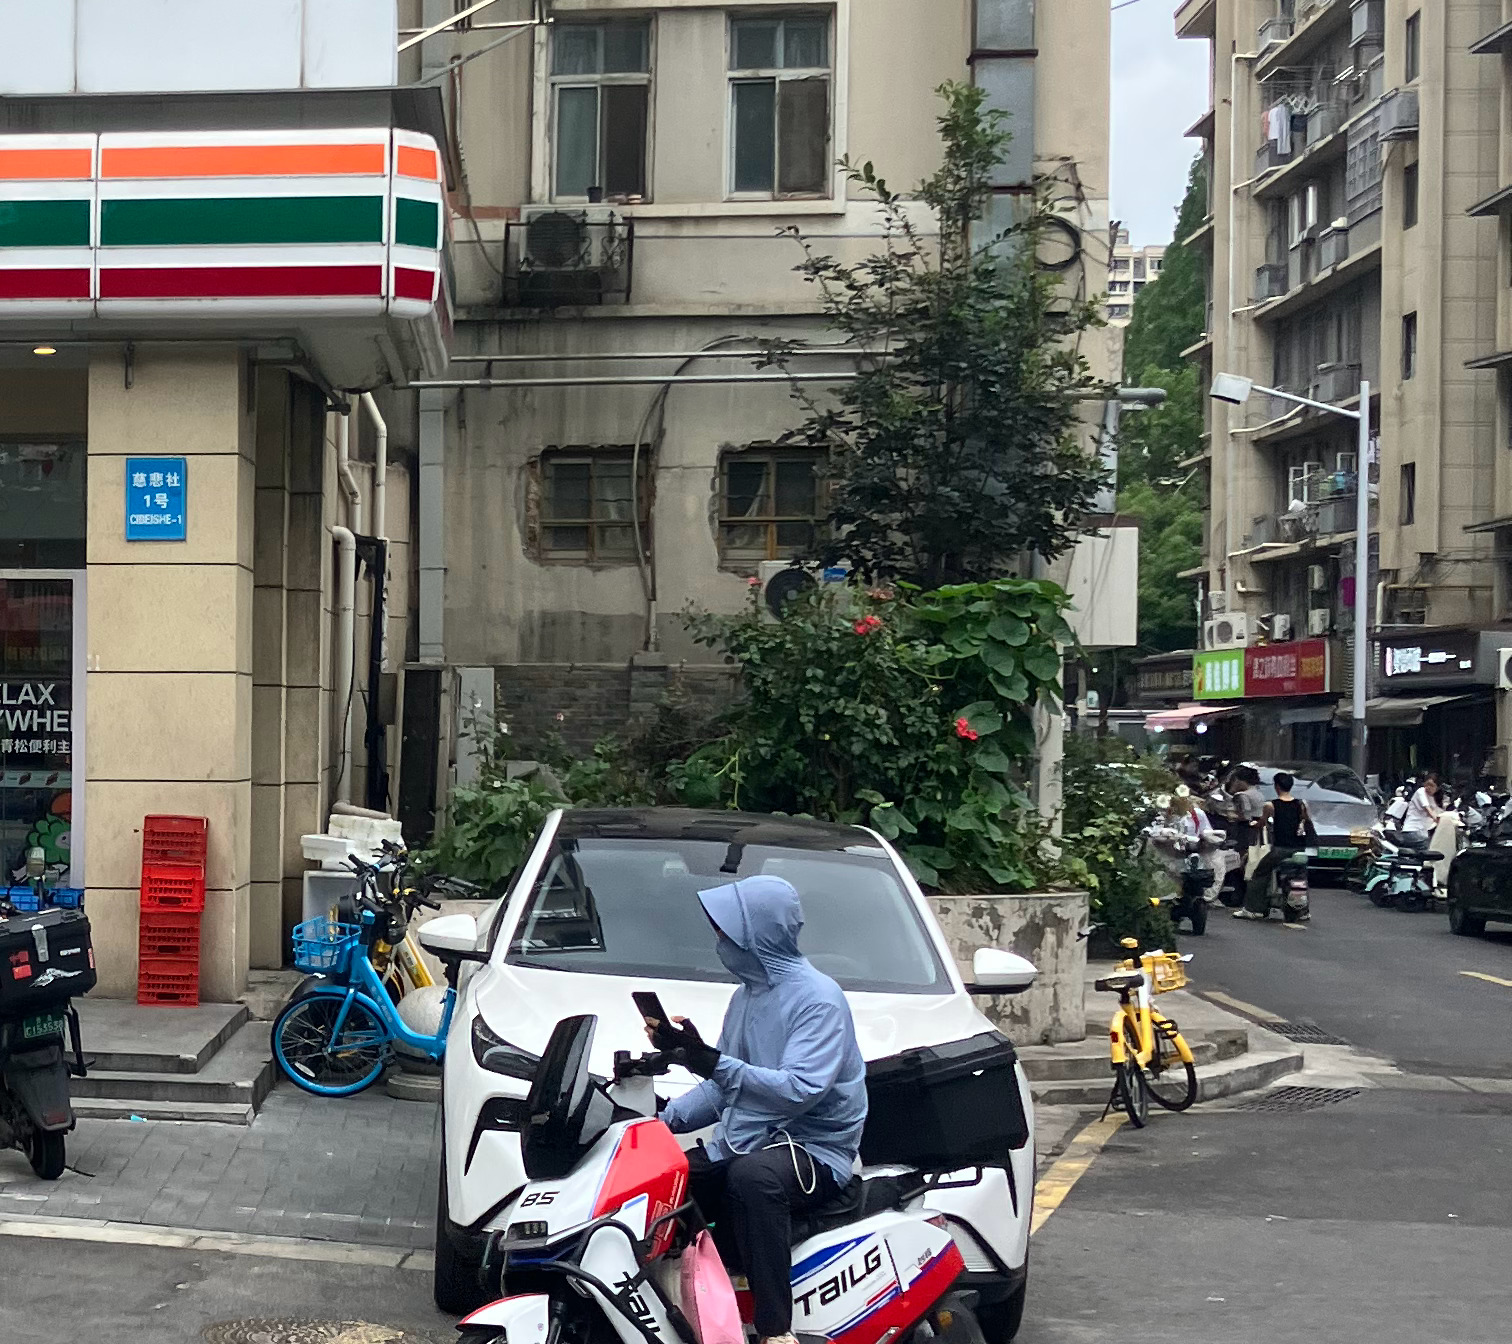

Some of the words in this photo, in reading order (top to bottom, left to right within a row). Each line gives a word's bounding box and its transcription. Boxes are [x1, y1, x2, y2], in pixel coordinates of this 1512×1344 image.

[131, 471, 180, 488] 慈悲社
[143, 492, 169, 509] 1号
